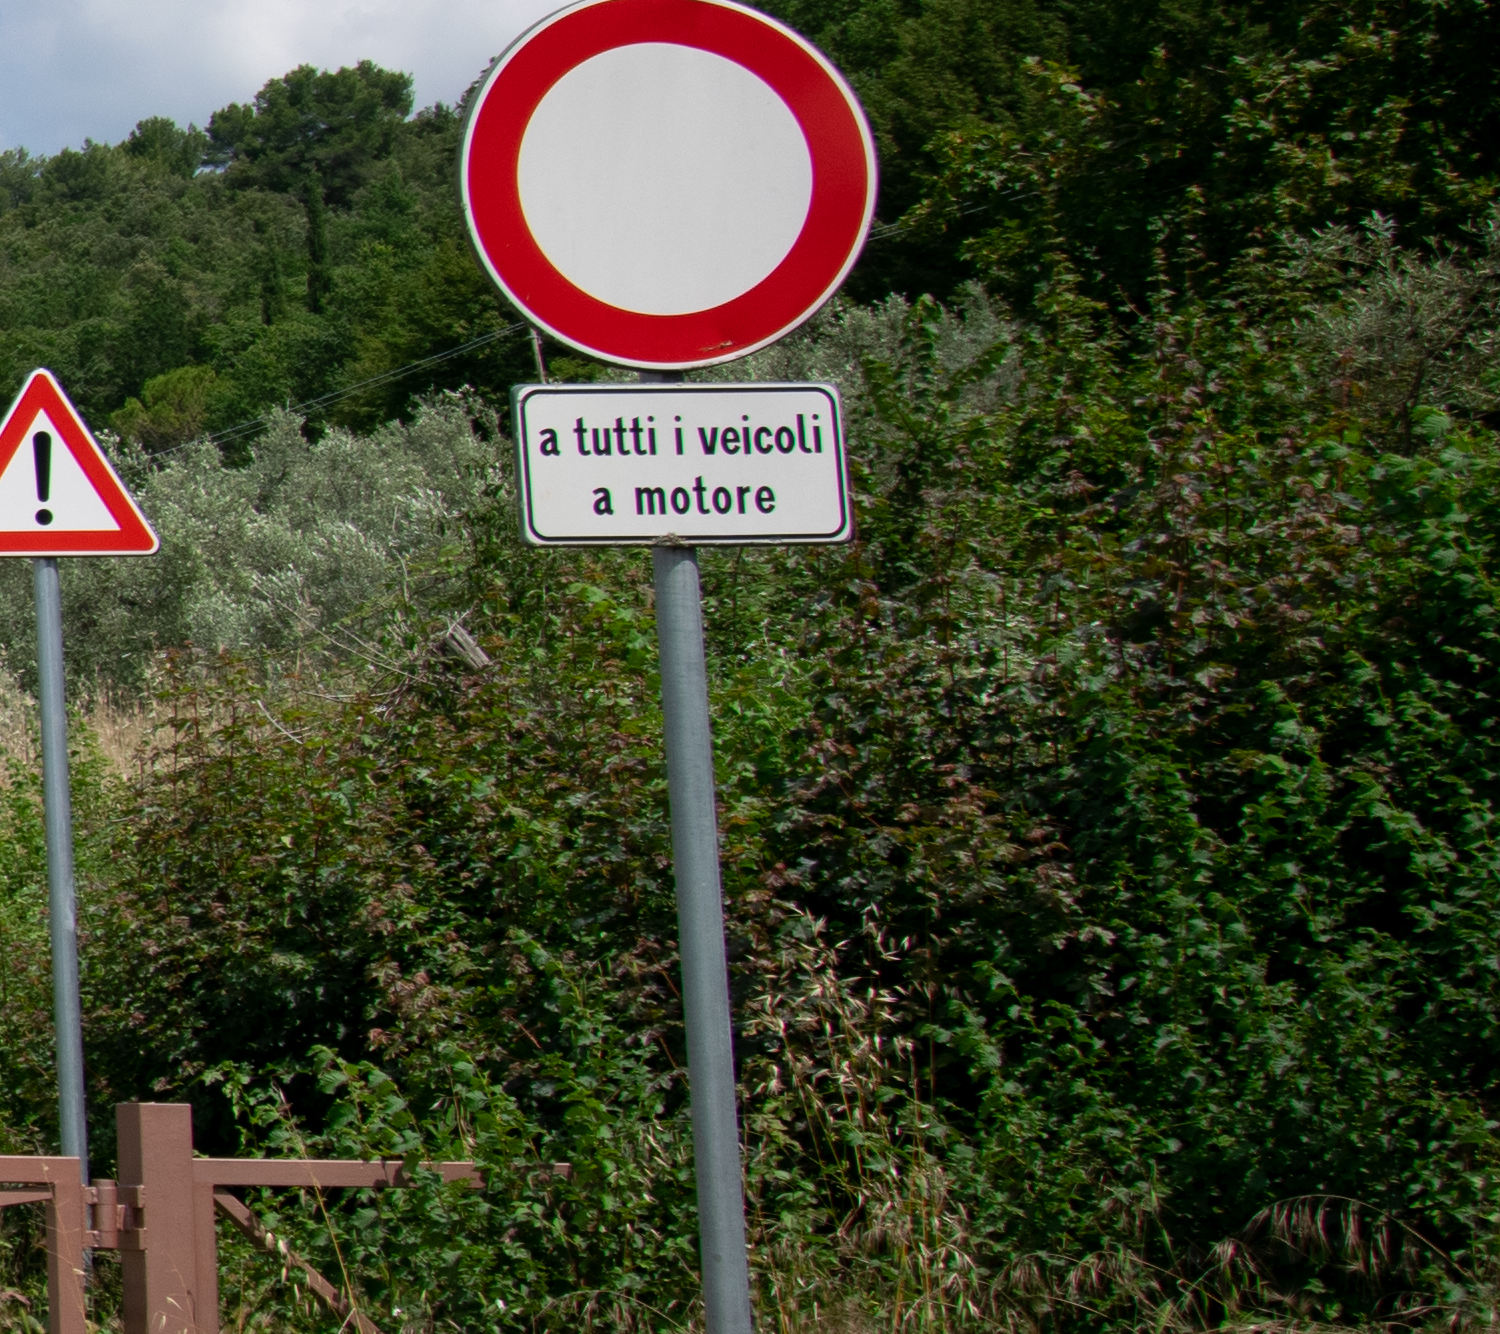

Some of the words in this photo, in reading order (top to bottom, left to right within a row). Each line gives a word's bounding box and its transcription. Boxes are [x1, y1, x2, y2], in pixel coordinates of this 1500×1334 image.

[539, 427, 560, 457] a
[574, 415, 657, 456] tutti
[675, 415, 684, 456] i
[699, 414, 824, 455] veicoli
[593, 486, 613, 516] a
[636, 475, 776, 516] motore
